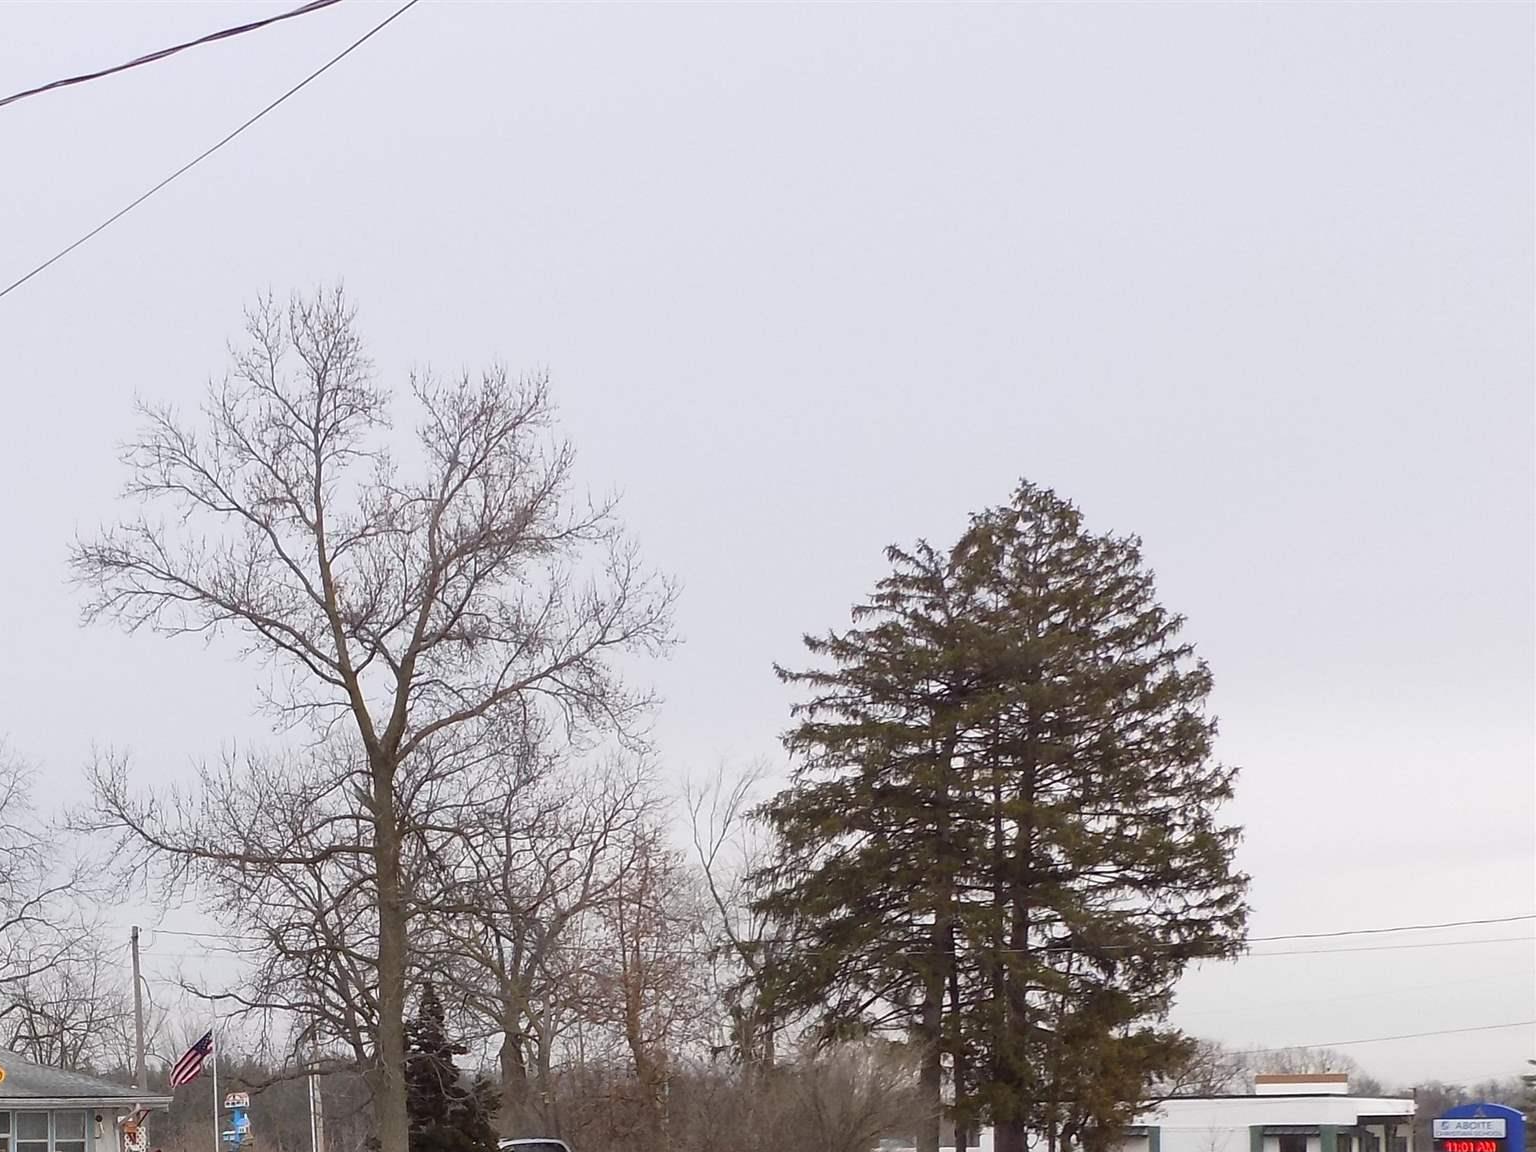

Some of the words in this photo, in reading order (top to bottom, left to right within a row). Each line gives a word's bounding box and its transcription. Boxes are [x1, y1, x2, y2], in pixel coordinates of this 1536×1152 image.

[1455, 1121, 1493, 1130] ABOITE
[1447, 1142, 1474, 1152] 11:01
[1476, 1142, 1496, 1152] AM
